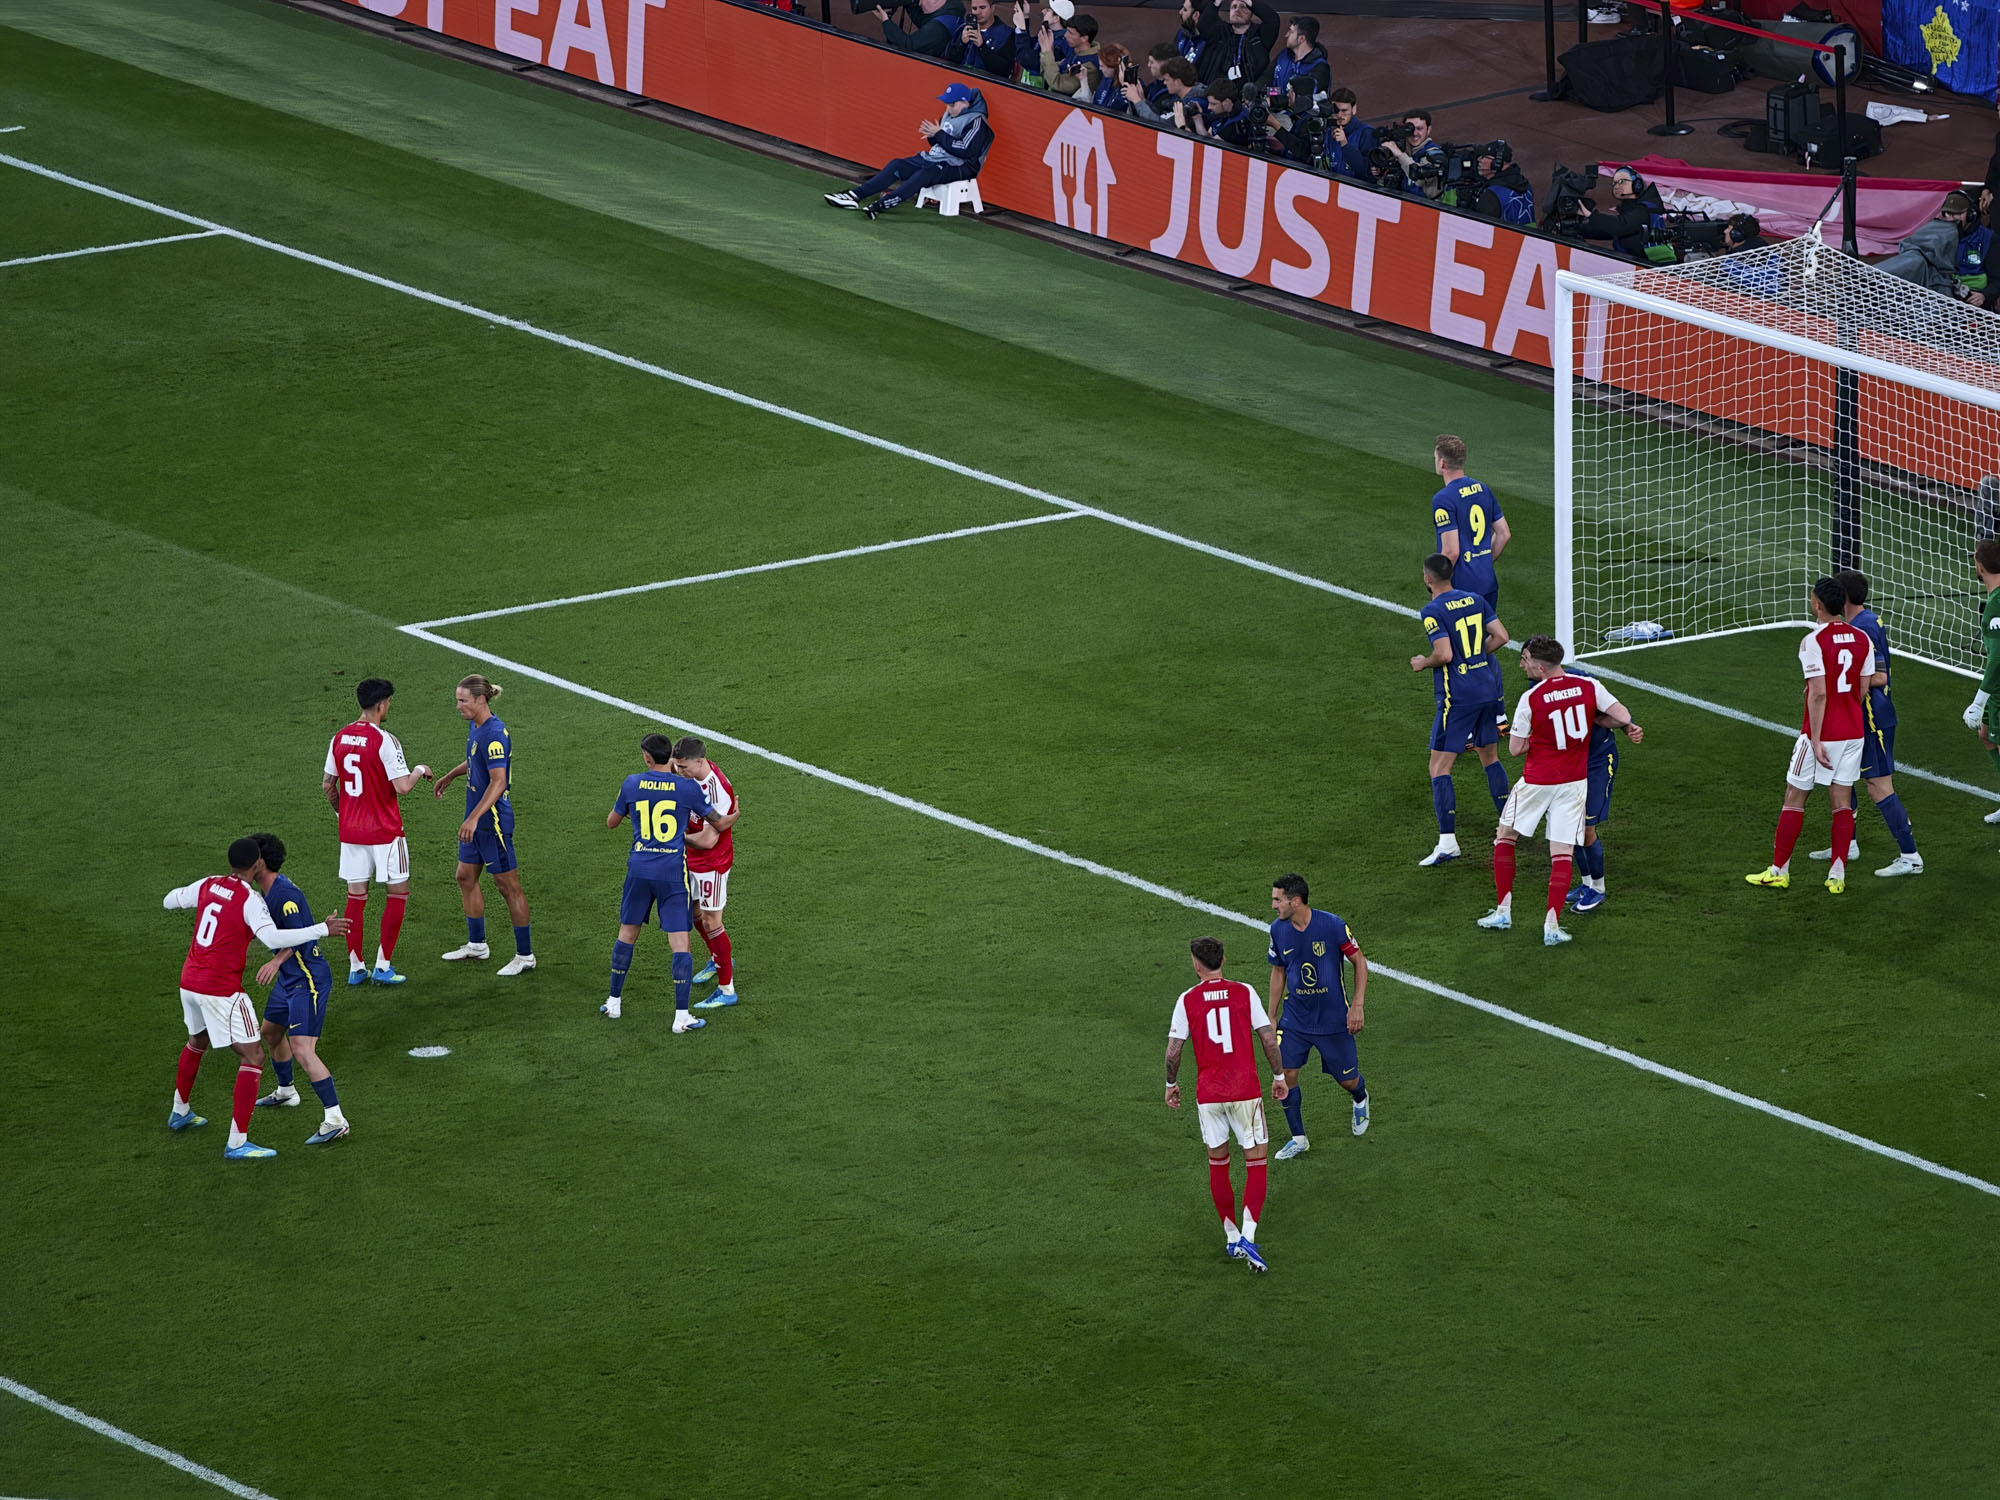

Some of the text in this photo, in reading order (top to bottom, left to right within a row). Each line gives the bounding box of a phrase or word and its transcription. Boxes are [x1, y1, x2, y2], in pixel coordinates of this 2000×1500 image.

[1149, 131, 1637, 382] JUST EAT
[1469, 504, 1486, 546] 9
[1455, 612, 1483, 659] 17
[1837, 648, 1853, 693] 2
[1548, 703, 1588, 750] 14
[343, 753, 363, 797] 5
[639, 780, 676, 791] MOLINA
[635, 799, 677, 843] 16
[699, 880, 713, 898] 19
[195, 902, 223, 948] 6
[1203, 989, 1229, 1001] WHITE
[1206, 1006, 1233, 1054] 4
